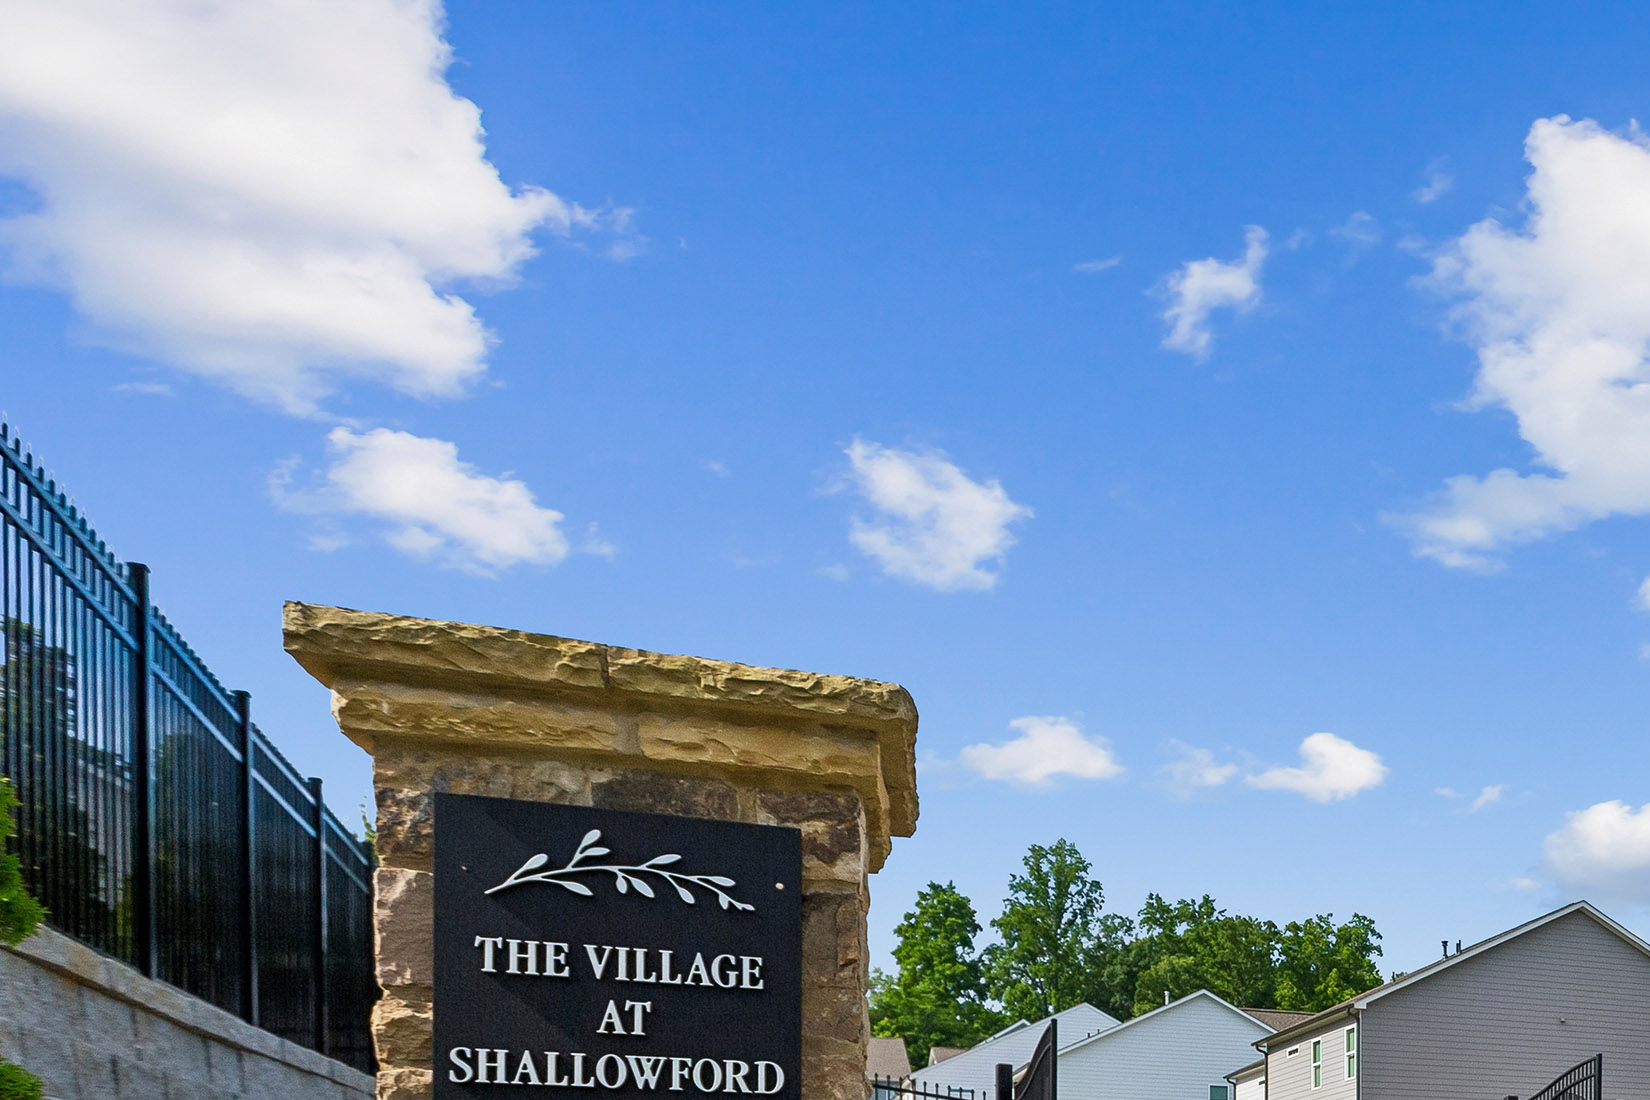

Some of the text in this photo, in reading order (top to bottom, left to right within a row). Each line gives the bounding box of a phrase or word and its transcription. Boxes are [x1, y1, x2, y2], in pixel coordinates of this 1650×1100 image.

[474, 935, 764, 990] THE VILLAGE
[596, 999, 651, 1036] AT
[448, 1046, 785, 1095] SHALLOWFORD
